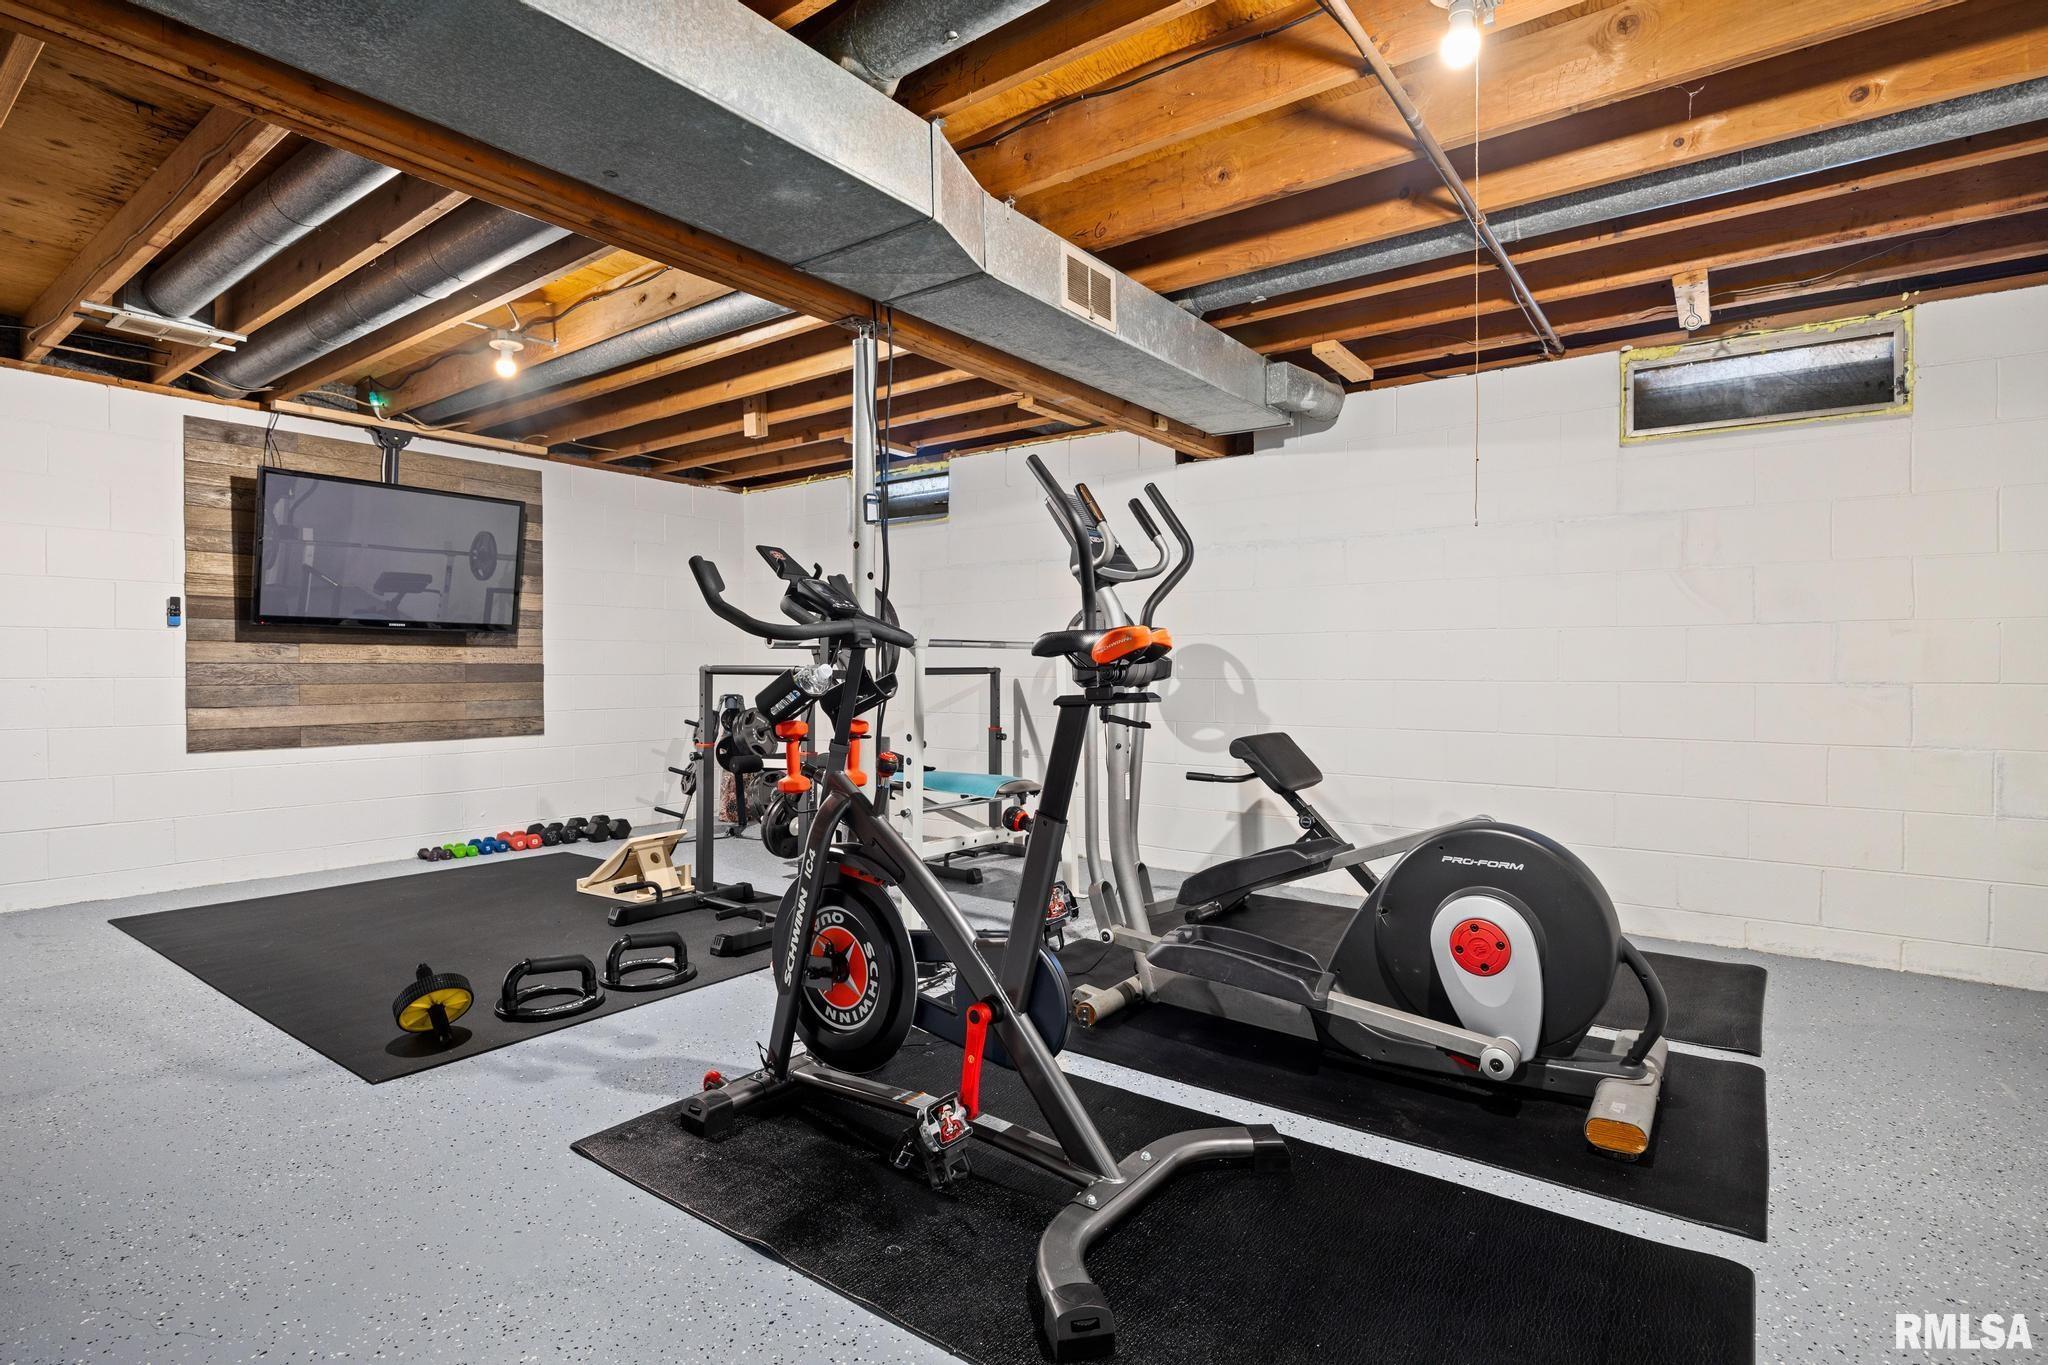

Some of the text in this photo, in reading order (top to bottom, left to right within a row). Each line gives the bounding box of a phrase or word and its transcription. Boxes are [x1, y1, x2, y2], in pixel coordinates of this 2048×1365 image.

[1441, 856, 1525, 871] PRO-FORM
[784, 849, 817, 987] SCHWINN IC4
[825, 941, 880, 1024] SCHWINN
